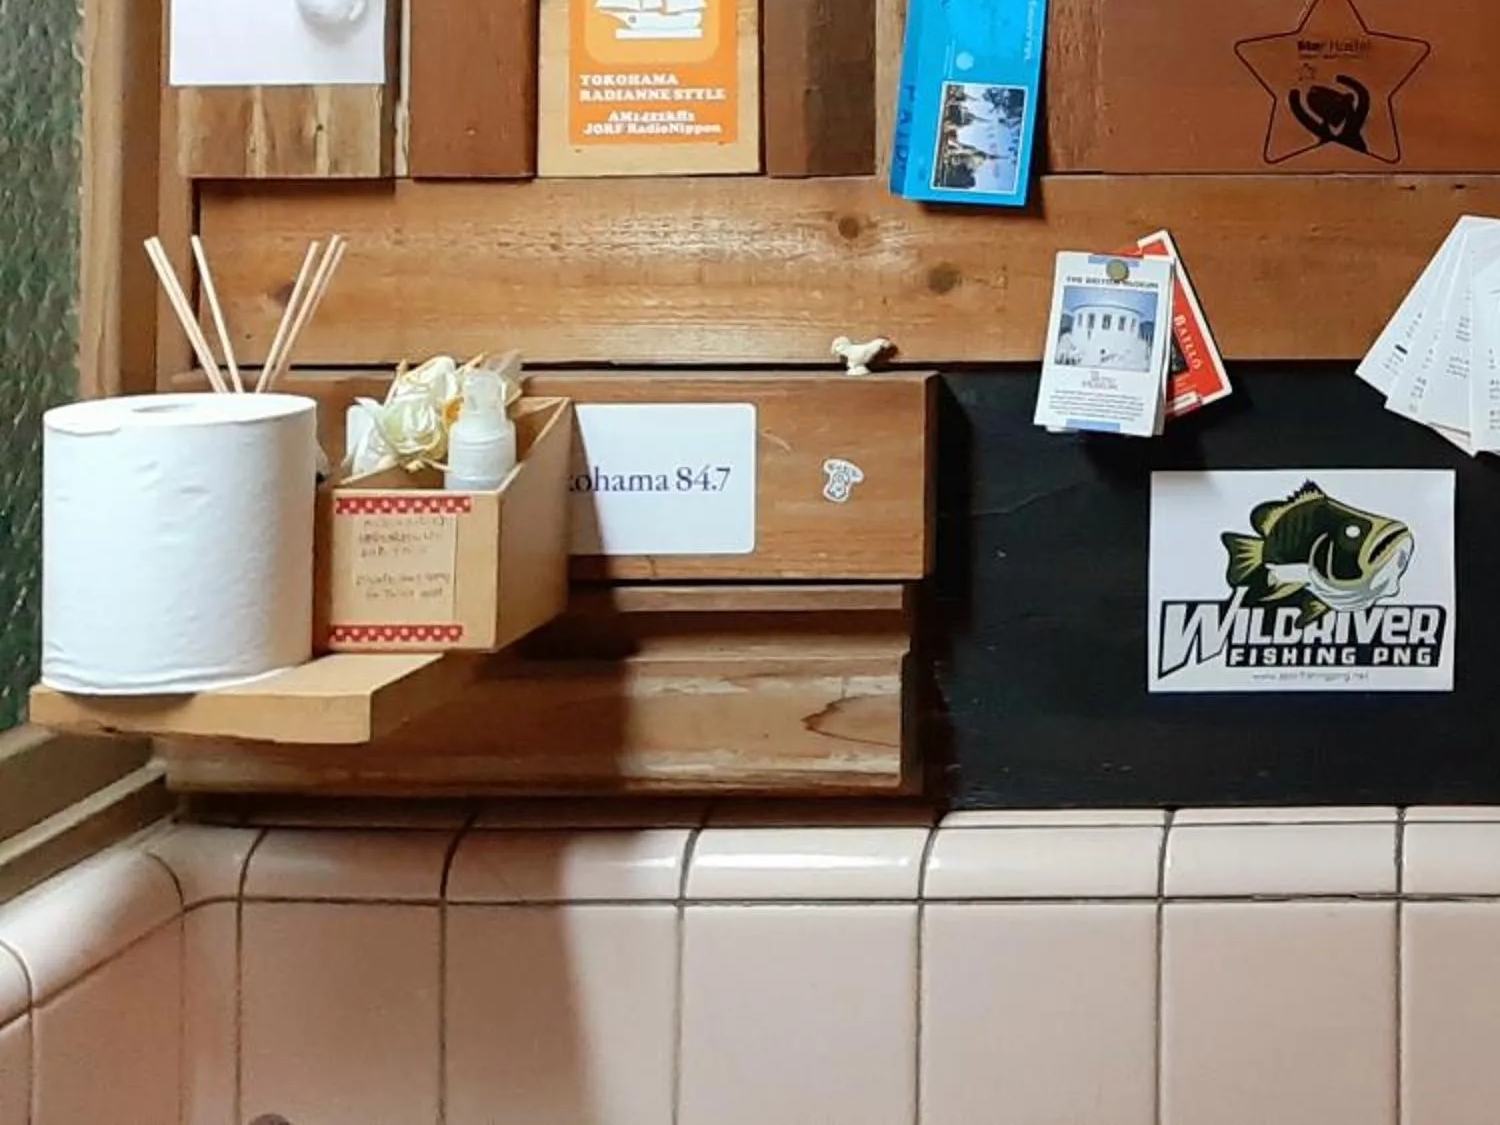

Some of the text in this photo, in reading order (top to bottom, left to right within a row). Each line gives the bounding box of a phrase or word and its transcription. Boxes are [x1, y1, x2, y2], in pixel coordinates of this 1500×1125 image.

[568, 464, 731, 493] ohama 84.7
[1229, 646, 1433, 666] FISHING PNG
